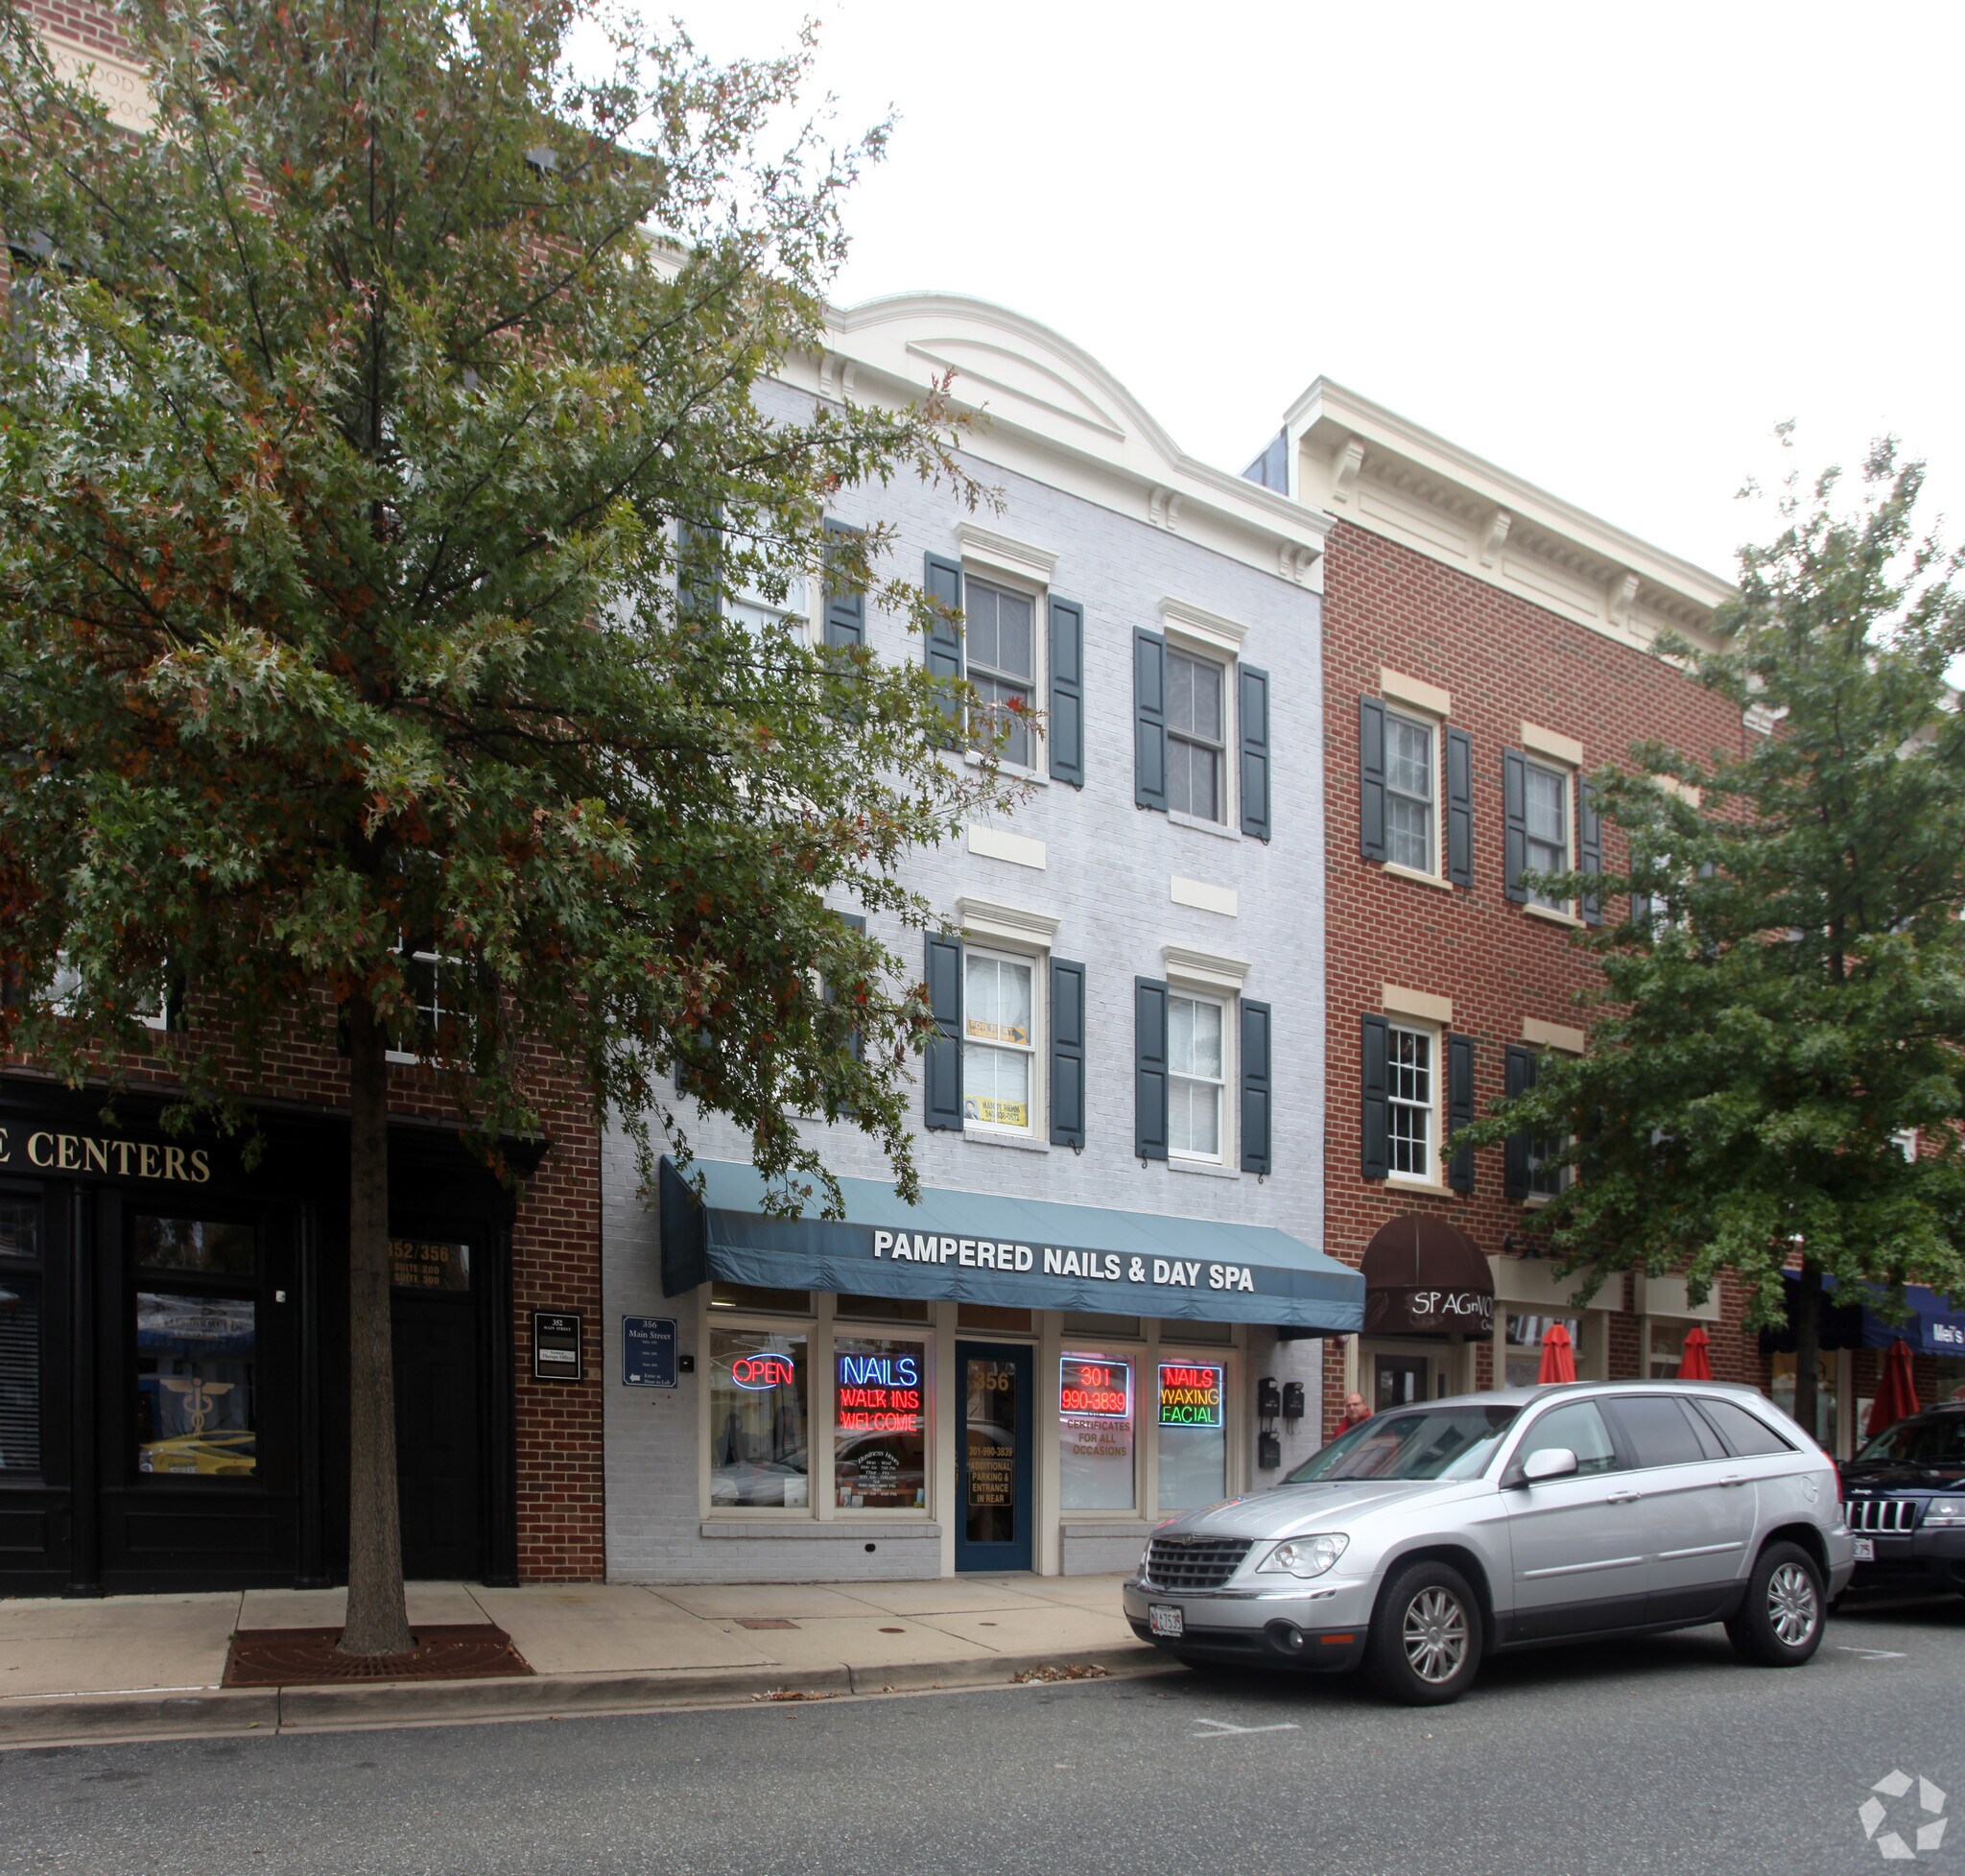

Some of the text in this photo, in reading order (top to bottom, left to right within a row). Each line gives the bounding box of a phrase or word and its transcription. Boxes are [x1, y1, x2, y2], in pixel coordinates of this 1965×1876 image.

[28, 1131, 211, 1183] CENTERS
[873, 1229, 1254, 1293] PAMPERED NAILS & DAY SPA
[393, 1272, 440, 1285] SUITE 300
[643, 1320, 657, 1329] 356
[628, 1329, 672, 1341] Main Street
[732, 1359, 793, 1385] OPEN
[844, 1356, 917, 1386] NAILS
[1080, 1367, 1110, 1387] 301
[1165, 1367, 1214, 1388] NAILS
[975, 1372, 1009, 1390] 356
[840, 1389, 920, 1409] WALK INS
[1062, 1389, 1126, 1411] 990-3839
[1161, 1389, 1219, 1405] WAXING
[840, 1412, 917, 1432] WELCOME
[1162, 1407, 1216, 1423] FACIAL
[1068, 1420, 1130, 1432] CERTIFICATES
[1079, 1434, 1116, 1443] FOR ALL
[969, 1446, 1013, 1457] 301-990-3839
[1074, 1445, 1127, 1457] OCCASIONS
[970, 1461, 1011, 1471] ADDITIONAL
[973, 1473, 1003, 1482] PARKING
[973, 1484, 1009, 1493] ENTRANCE
[977, 1494, 984, 1503] IN
